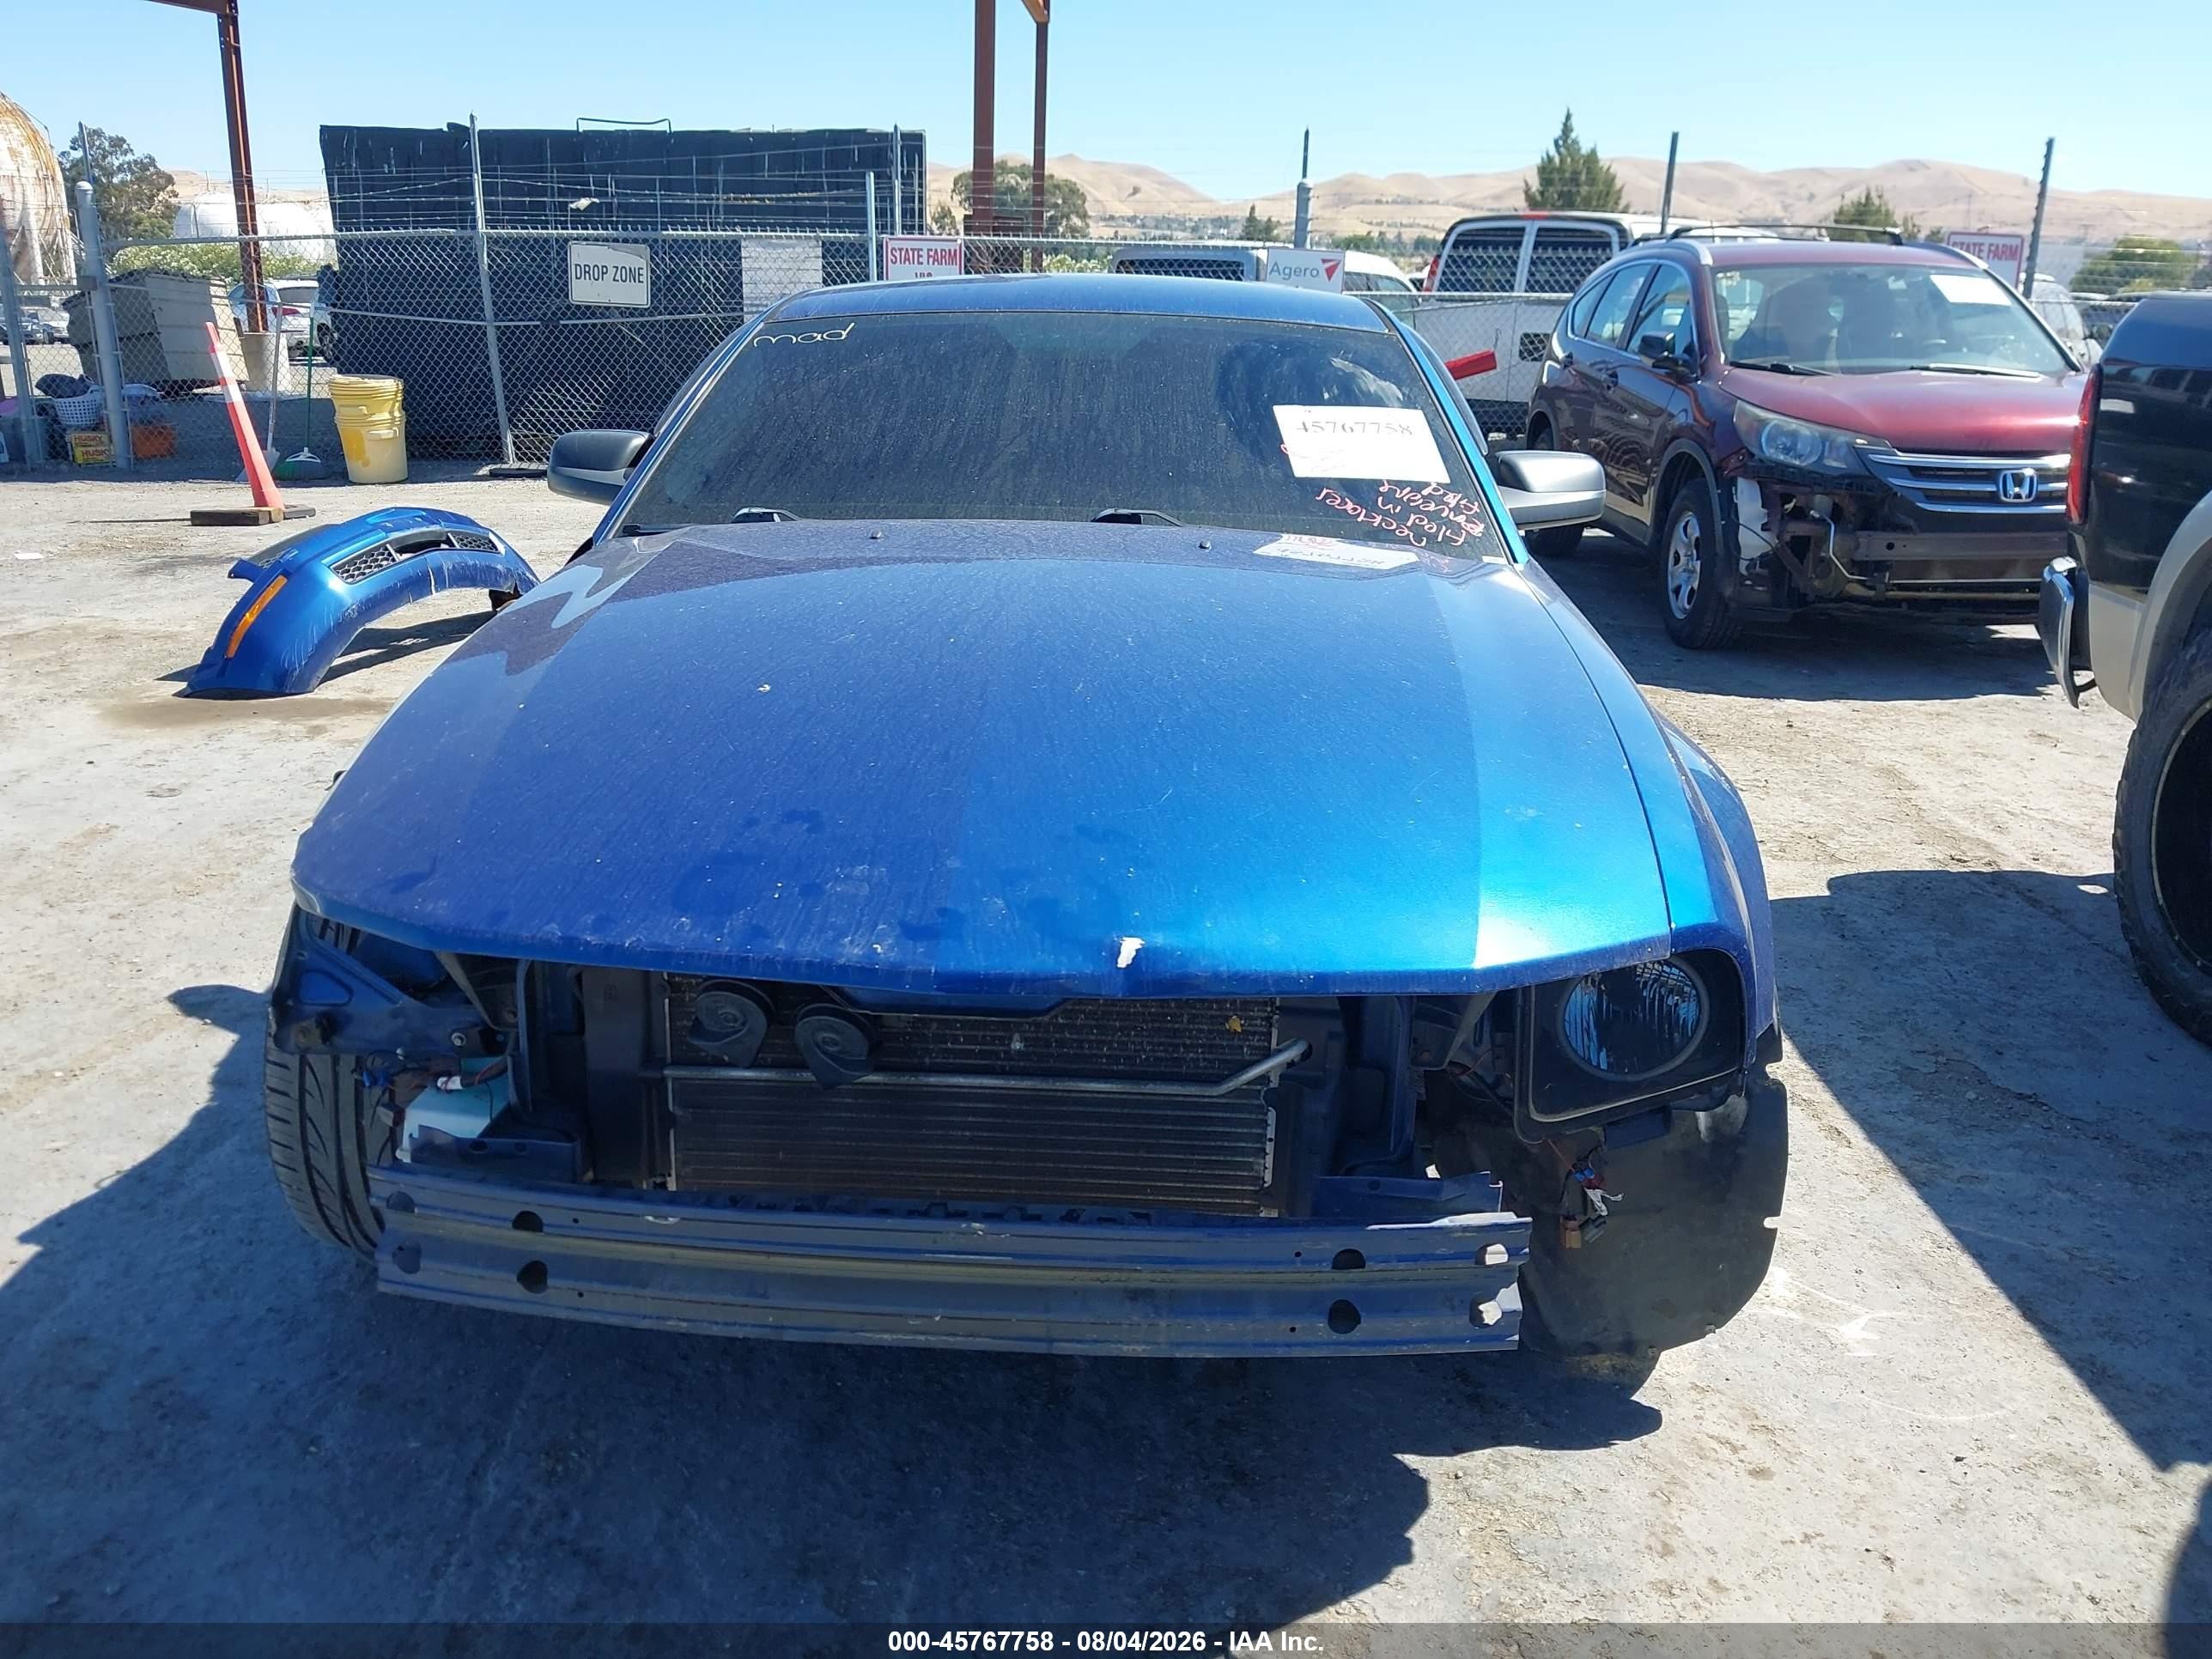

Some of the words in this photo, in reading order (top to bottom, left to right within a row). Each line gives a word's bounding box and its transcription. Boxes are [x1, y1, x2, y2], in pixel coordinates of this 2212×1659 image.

[890, 246, 924, 265] STATE
[927, 247, 957, 266] FARM
[1987, 243, 2020, 261] FARM
[574, 263, 609, 282] DROP
[612, 265, 644, 284] ZONE
[1269, 261, 1320, 282] Agero
[753, 322, 855, 348] mad
